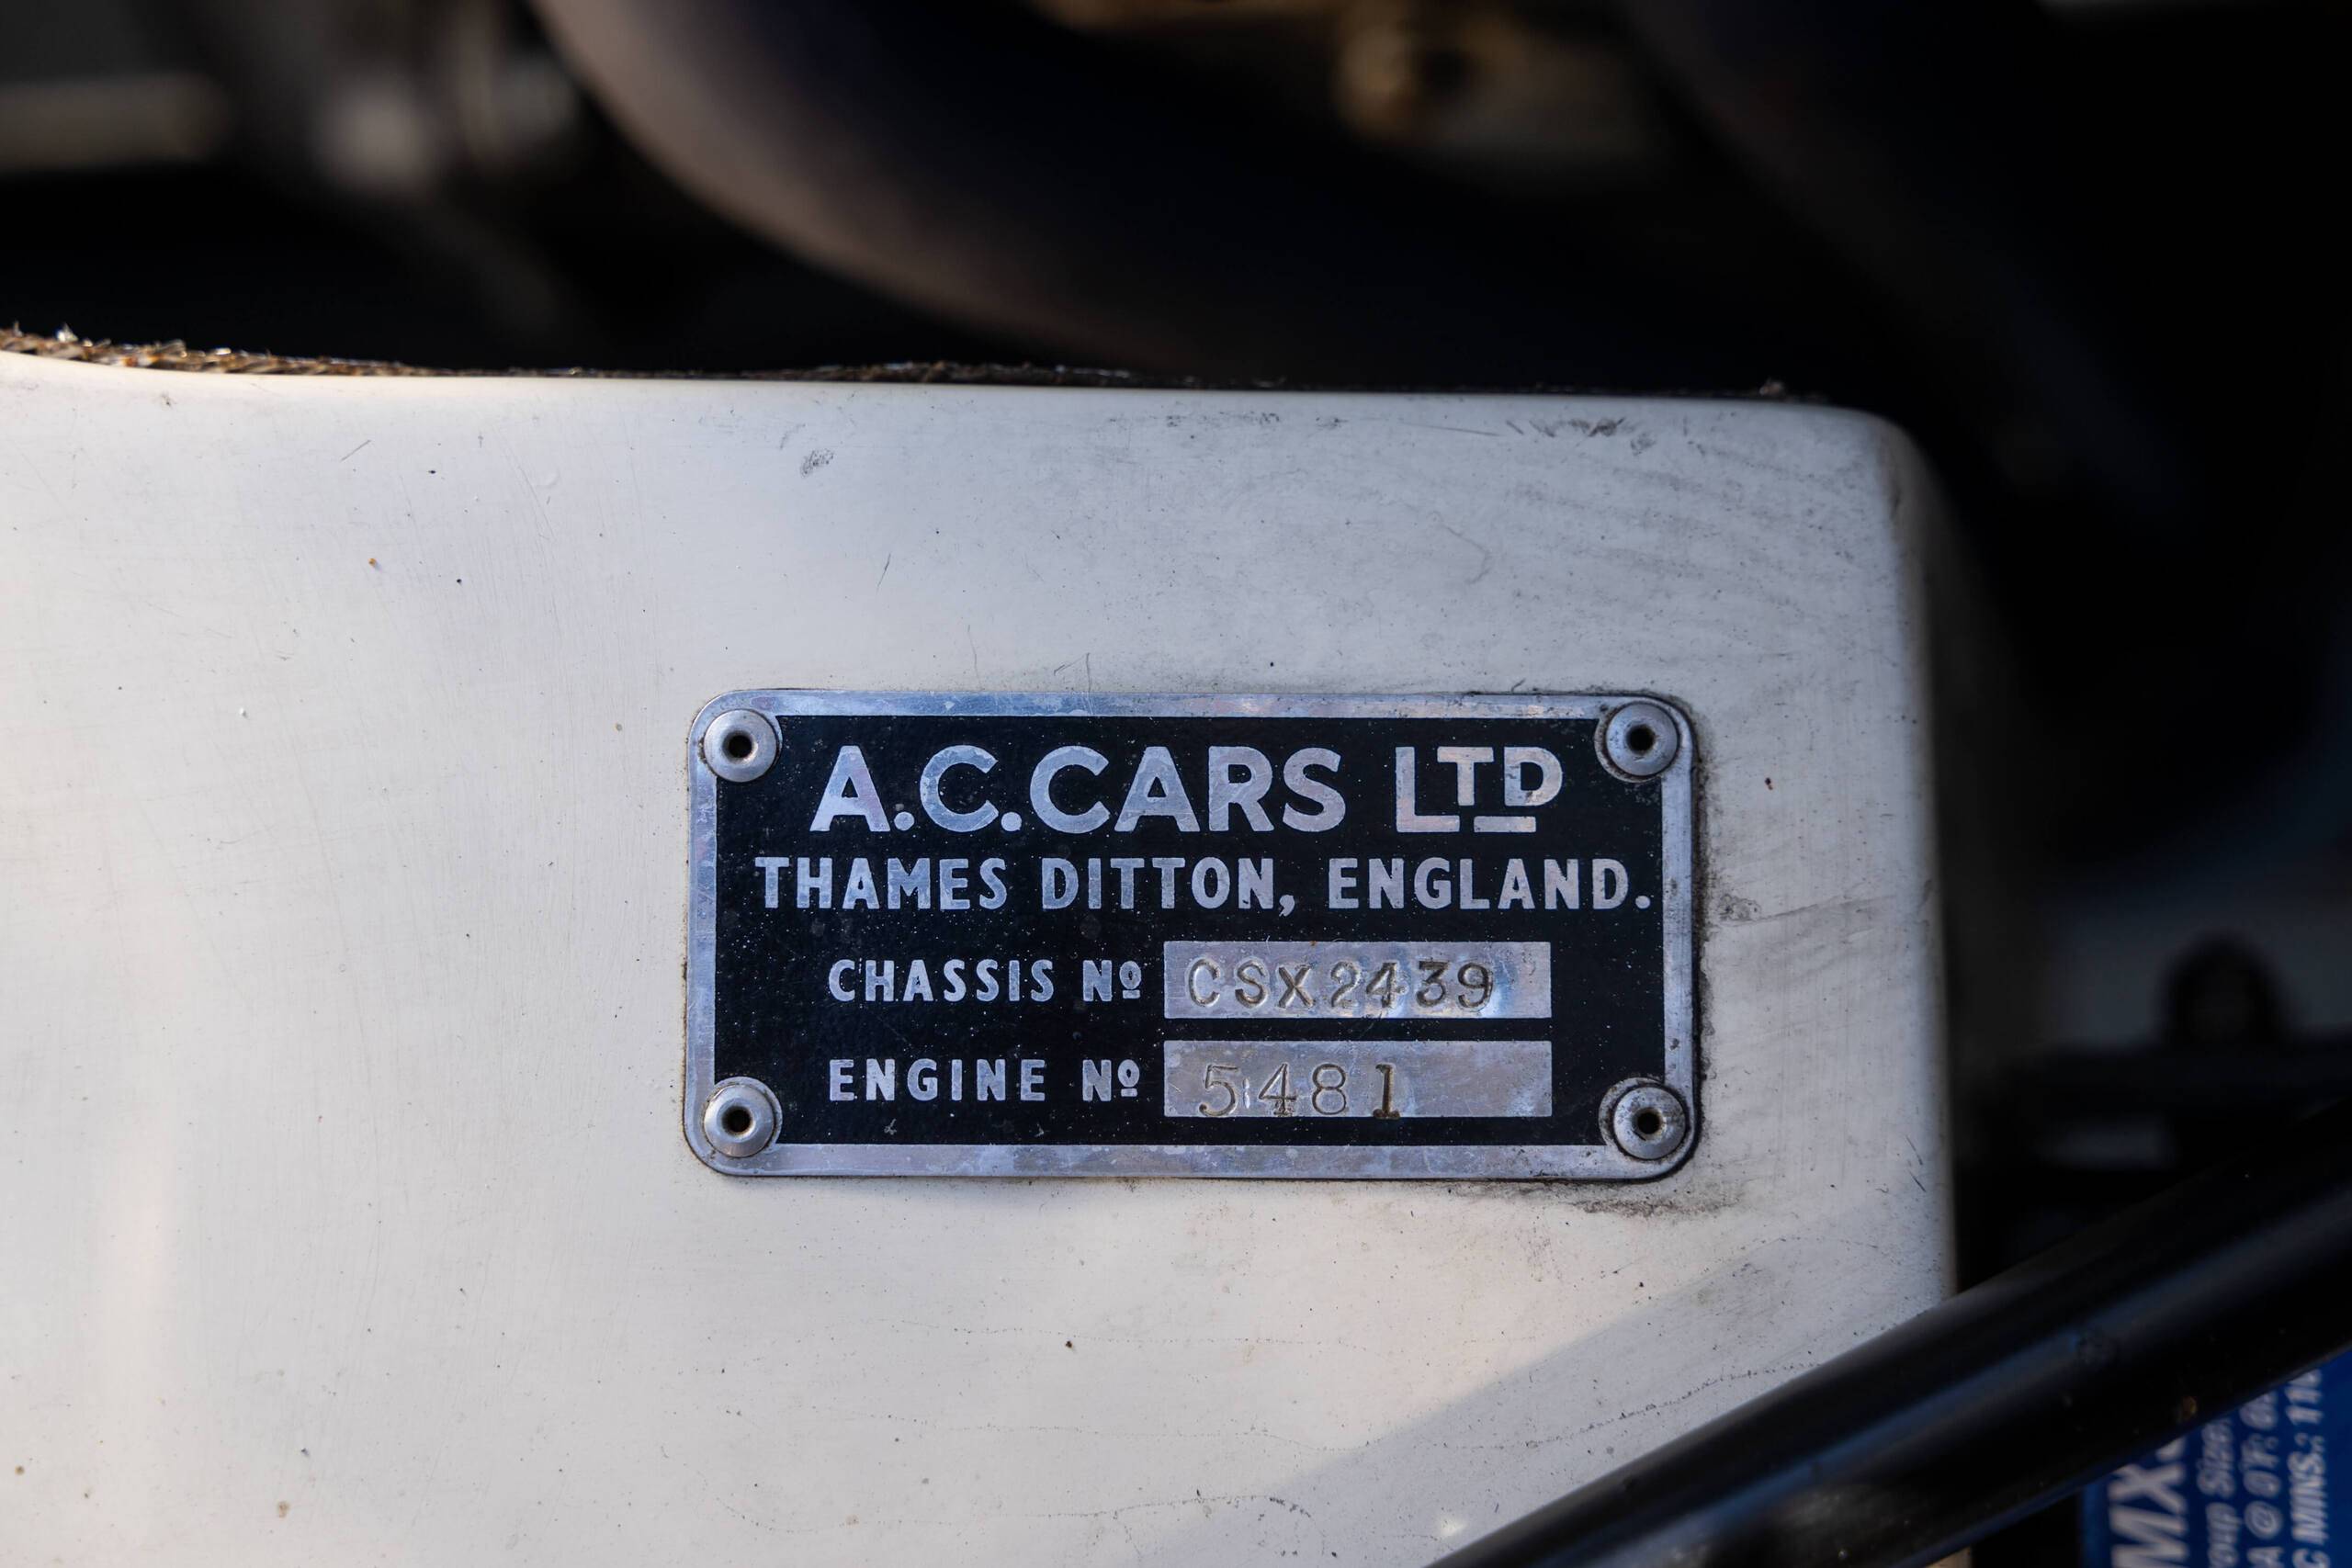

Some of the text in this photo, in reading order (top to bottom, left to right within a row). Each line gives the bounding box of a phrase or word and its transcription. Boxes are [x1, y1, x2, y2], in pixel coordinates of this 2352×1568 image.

[1395, 746, 1564, 833] LTD
[754, 856, 1651, 917] THAMES DITTON, ENGLAND.
[828, 958, 1055, 1002] CHASSIS
[1188, 958, 1495, 1009] CSX2439
[829, 1058, 1046, 1101] ENGINE
[1198, 1062, 1401, 1120] 5481
